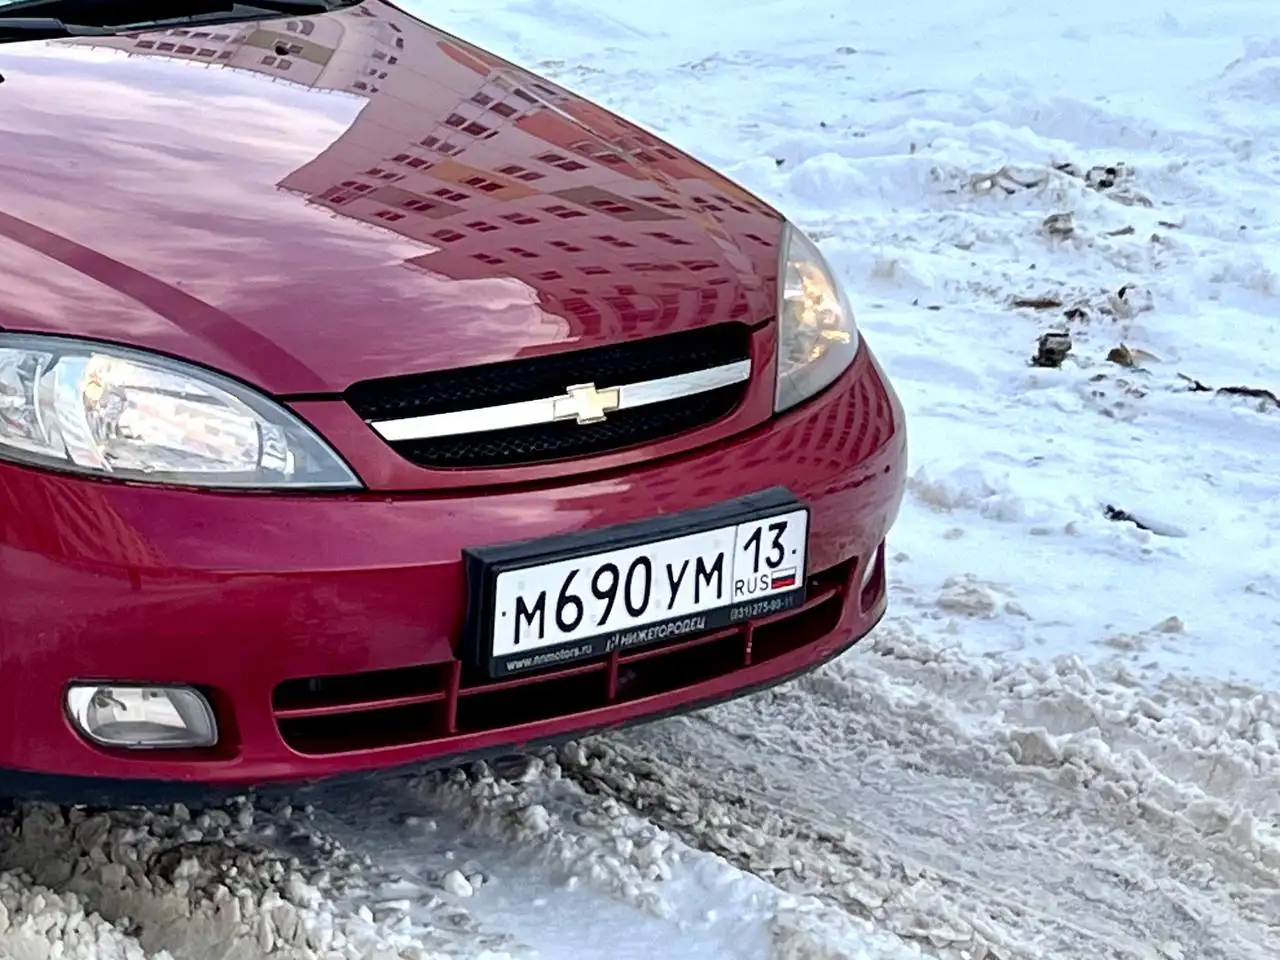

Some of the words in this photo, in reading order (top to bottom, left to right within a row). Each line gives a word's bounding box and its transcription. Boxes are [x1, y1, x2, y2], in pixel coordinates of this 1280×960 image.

[743, 521, 788, 573] 13
[734, 574, 770, 597] RUS
[621, 616, 706, 646] НИЖЕГОРОДЕЦ
